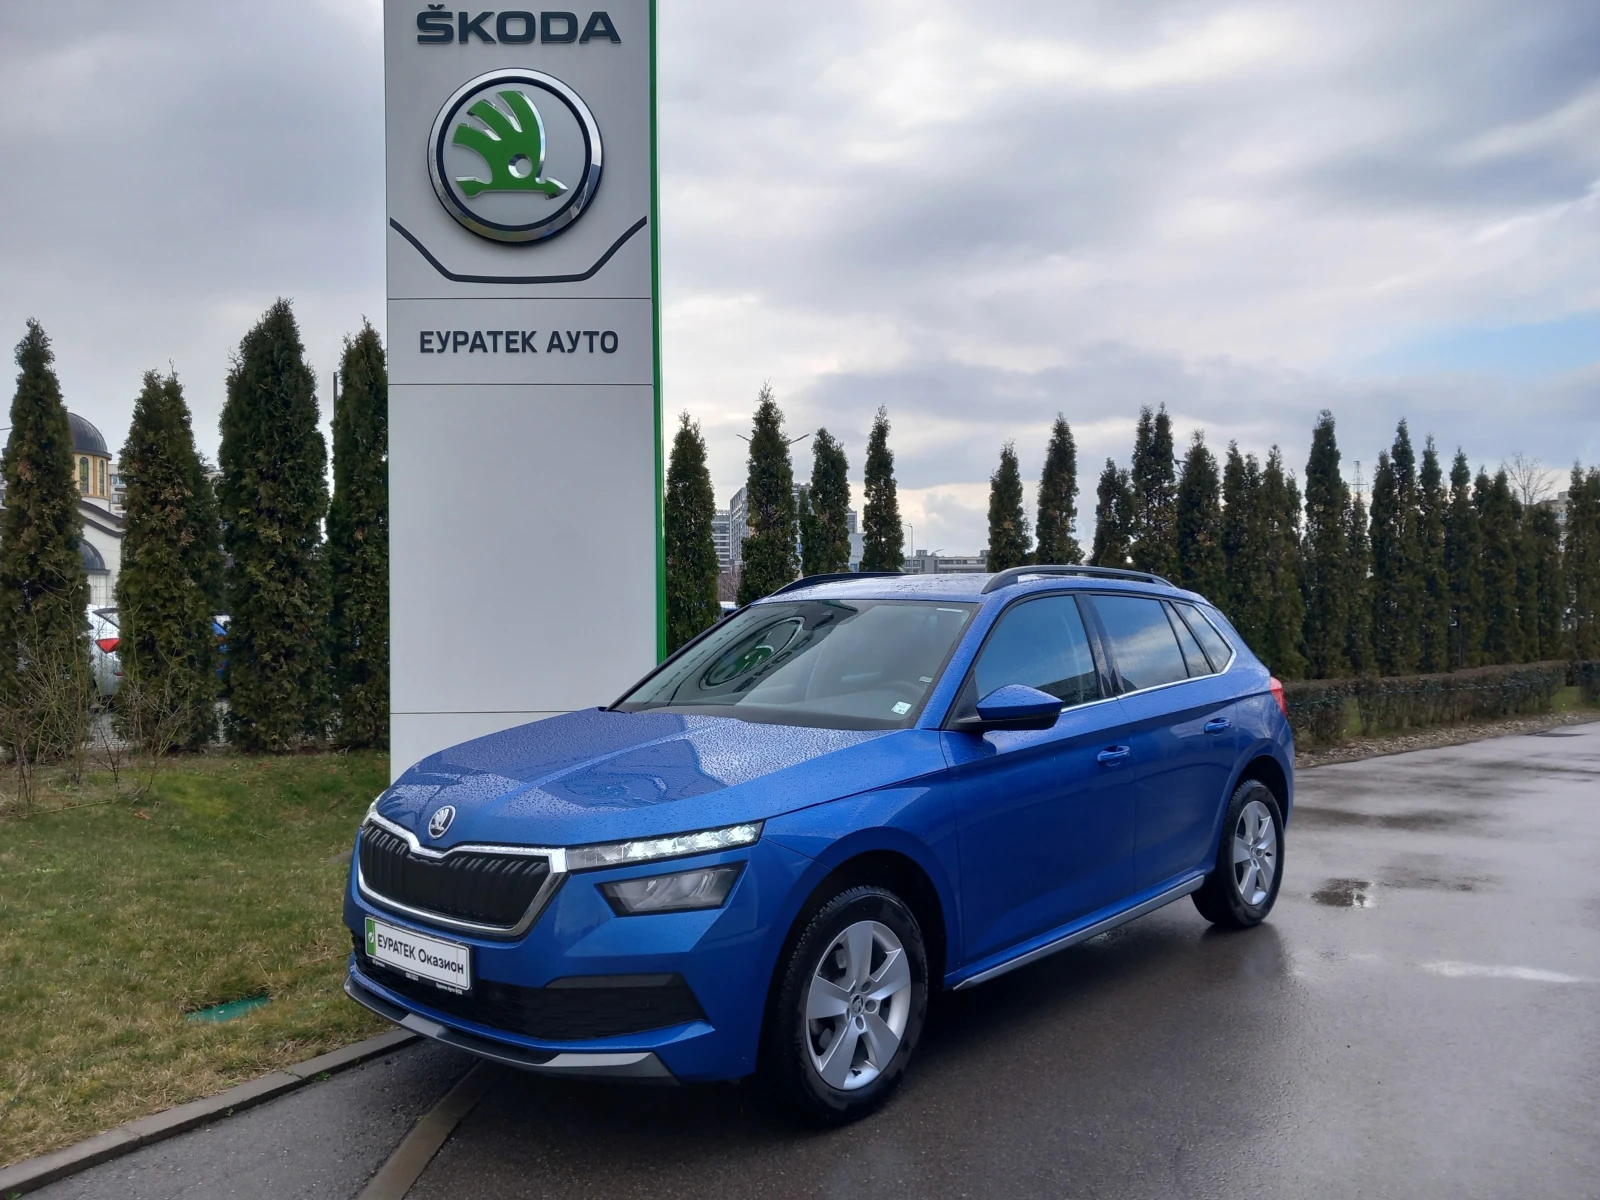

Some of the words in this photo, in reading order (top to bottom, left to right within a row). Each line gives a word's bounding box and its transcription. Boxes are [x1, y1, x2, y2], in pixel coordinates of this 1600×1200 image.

[416, 4, 622, 44] ŠKODA
[419, 330, 538, 354] ЕУРАТЕК
[546, 330, 619, 354] АУТО
[377, 933, 416, 960] ЕУРАТЕК
[418, 948, 464, 975] Оказион
